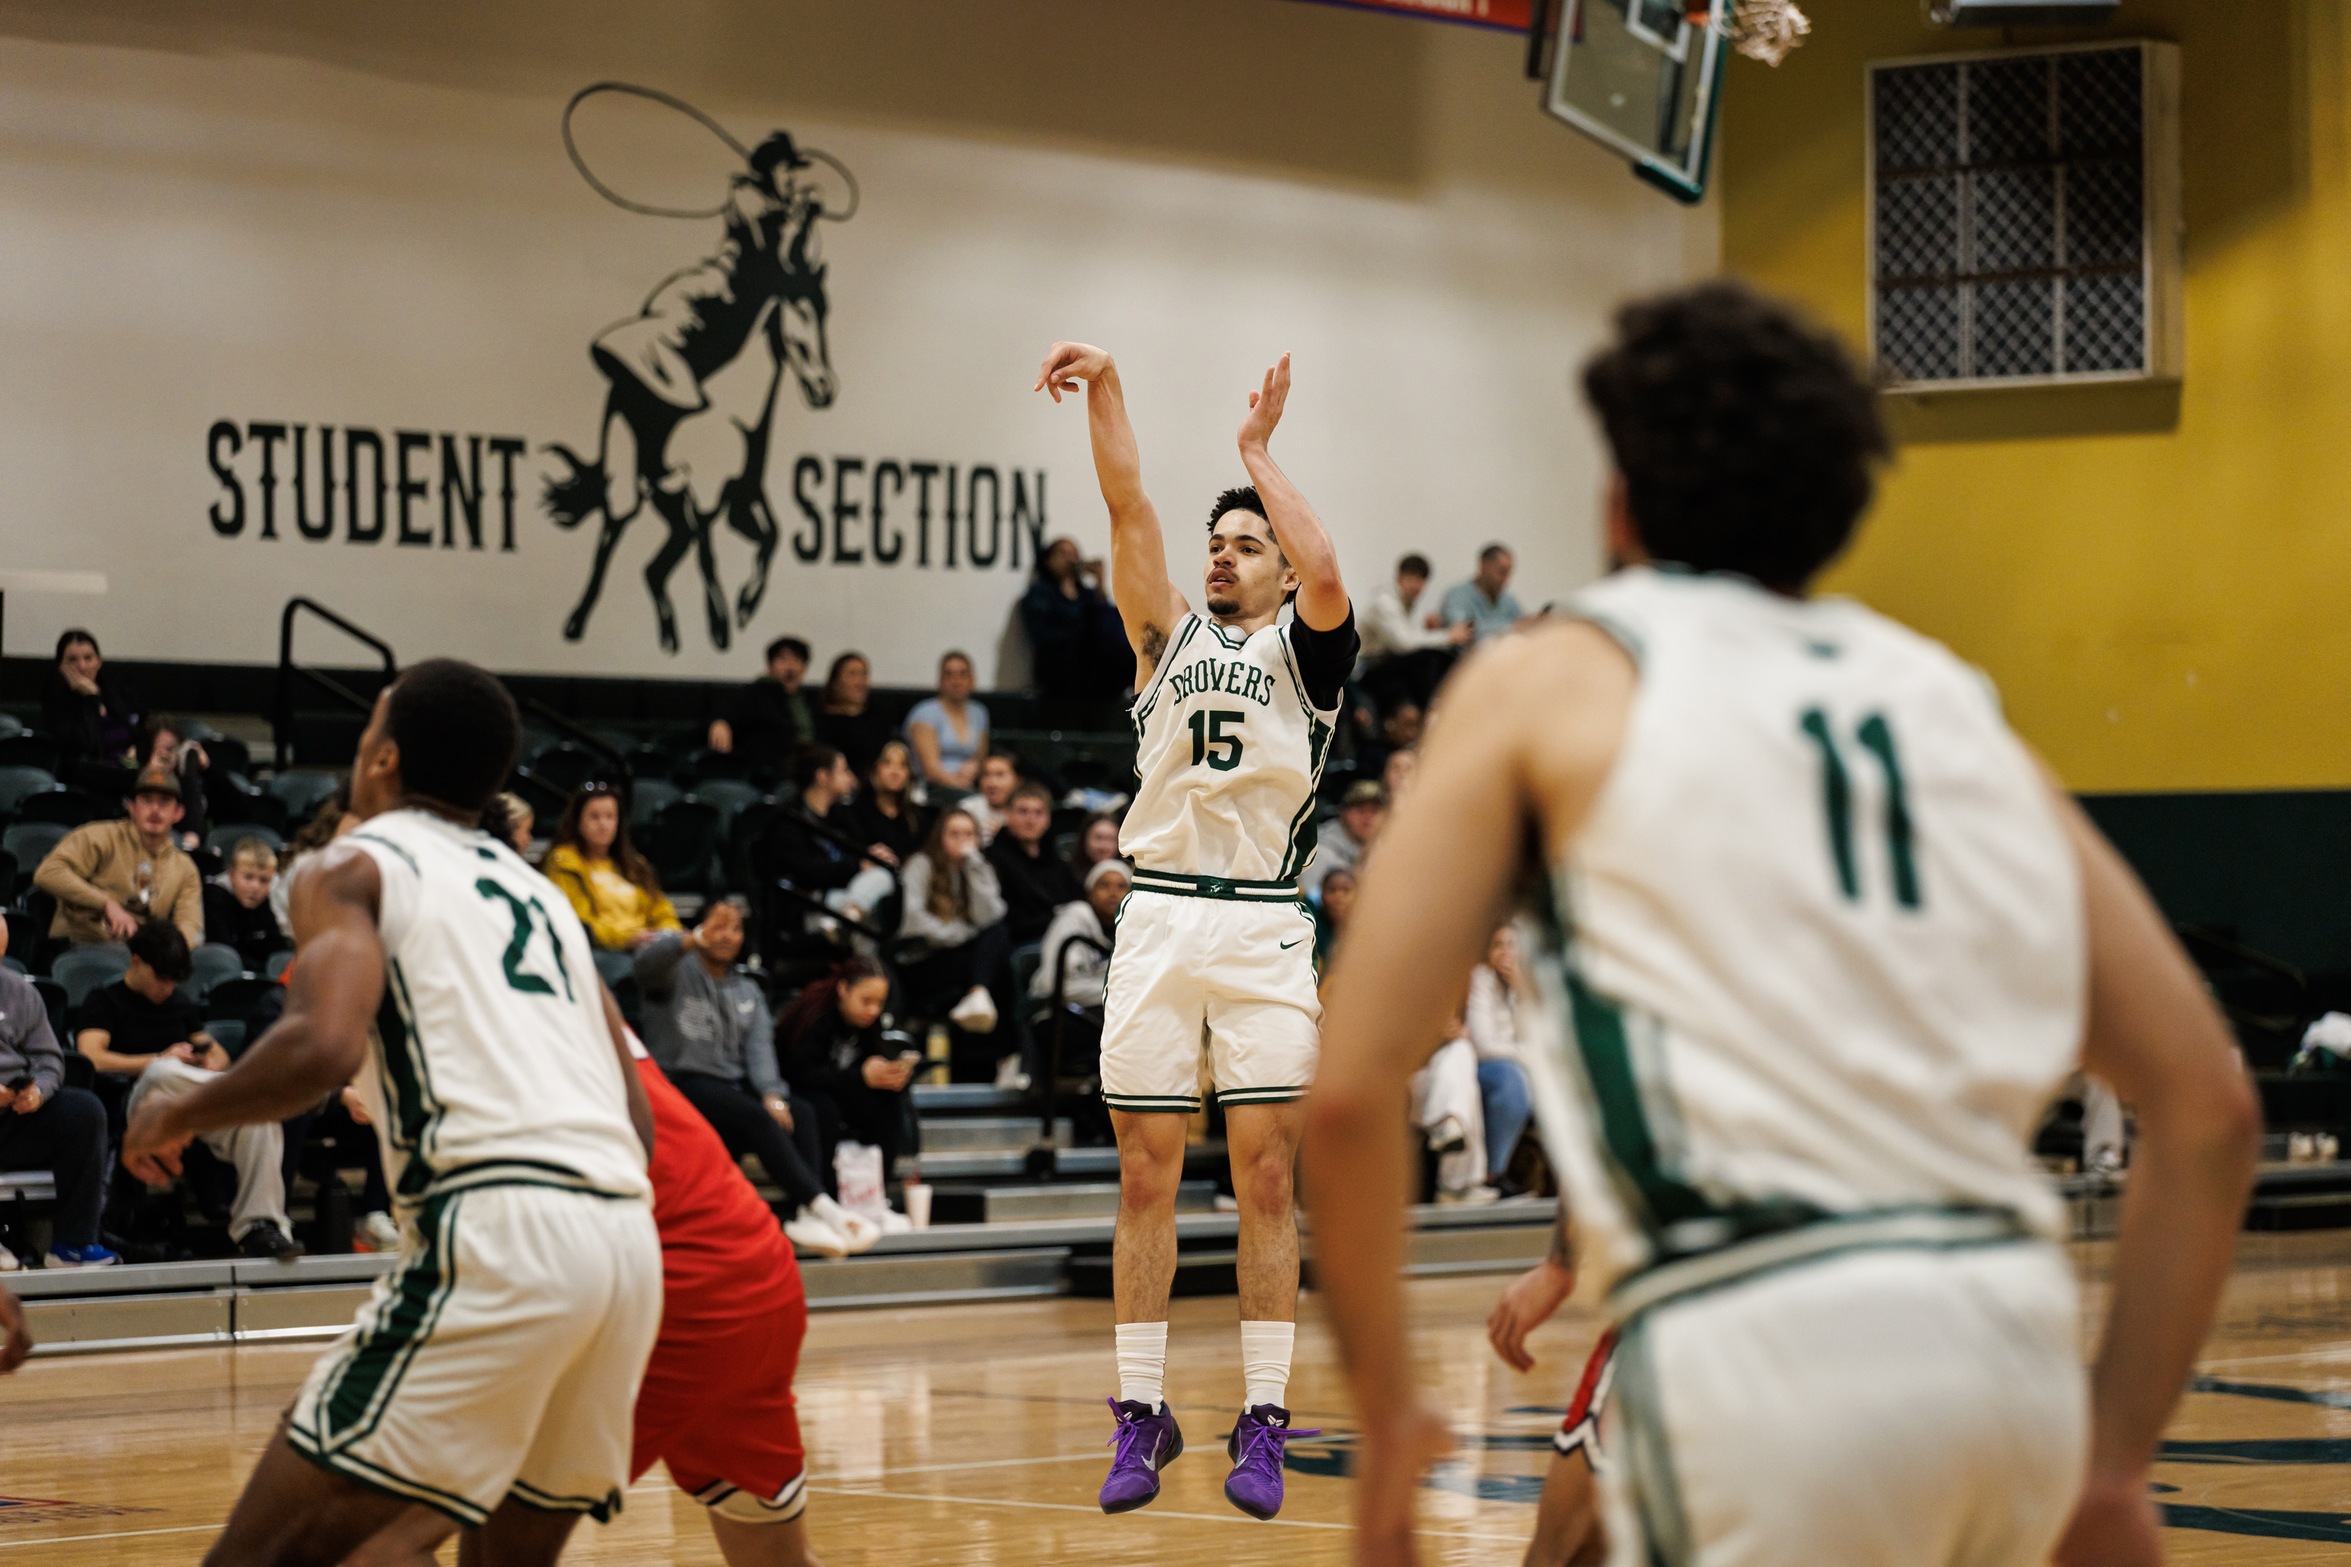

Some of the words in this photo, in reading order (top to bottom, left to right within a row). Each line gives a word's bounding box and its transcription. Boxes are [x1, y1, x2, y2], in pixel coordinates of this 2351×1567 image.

[206, 419, 526, 552] STUDENT
[792, 455, 1044, 570] SECTION
[1169, 657, 1276, 707] DROVERS
[1188, 709, 1245, 772] 15
[1799, 706, 1921, 911] 11
[475, 877, 576, 1004] 21
